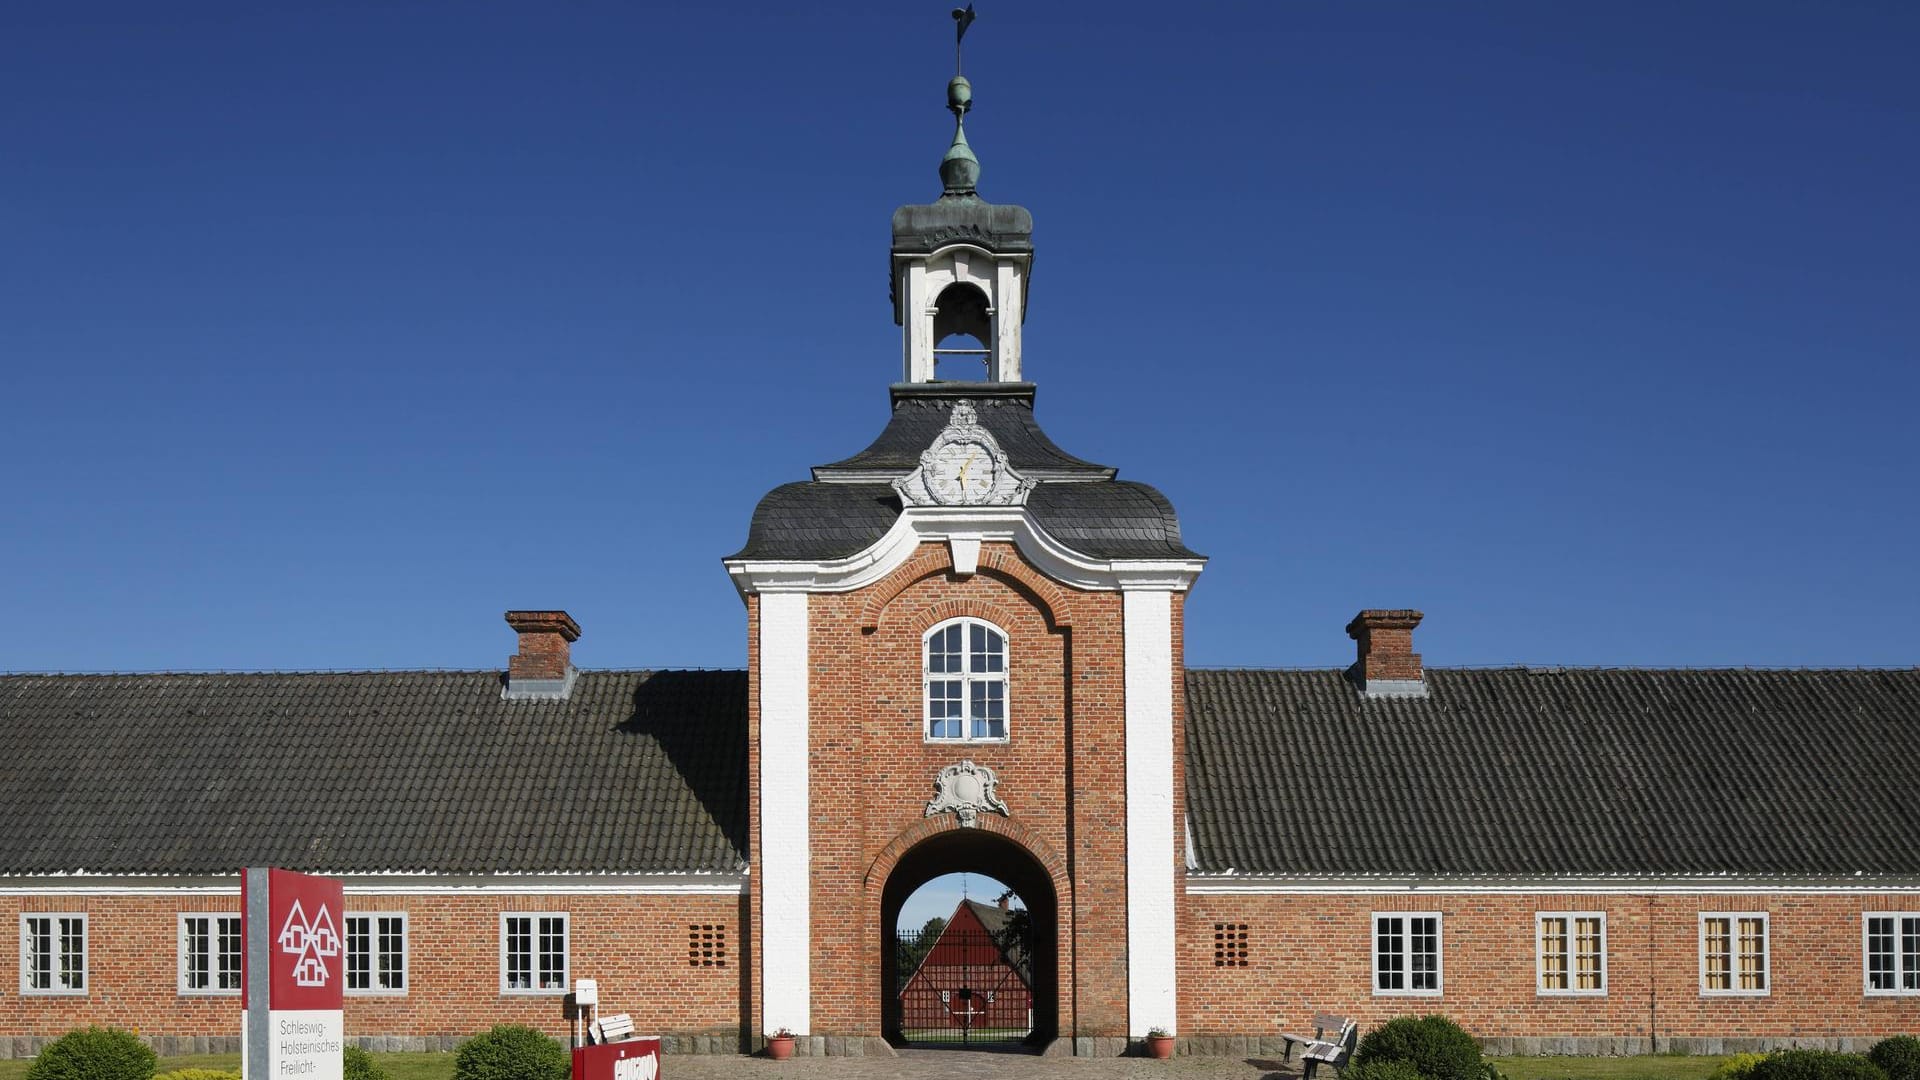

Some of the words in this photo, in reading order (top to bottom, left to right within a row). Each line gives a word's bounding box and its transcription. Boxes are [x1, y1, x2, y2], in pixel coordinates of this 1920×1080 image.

[280, 1019, 327, 1037] Schleswig-
[280, 1039, 340, 1055] Holsteinisches
[280, 1059, 317, 1075] Freilicht-
